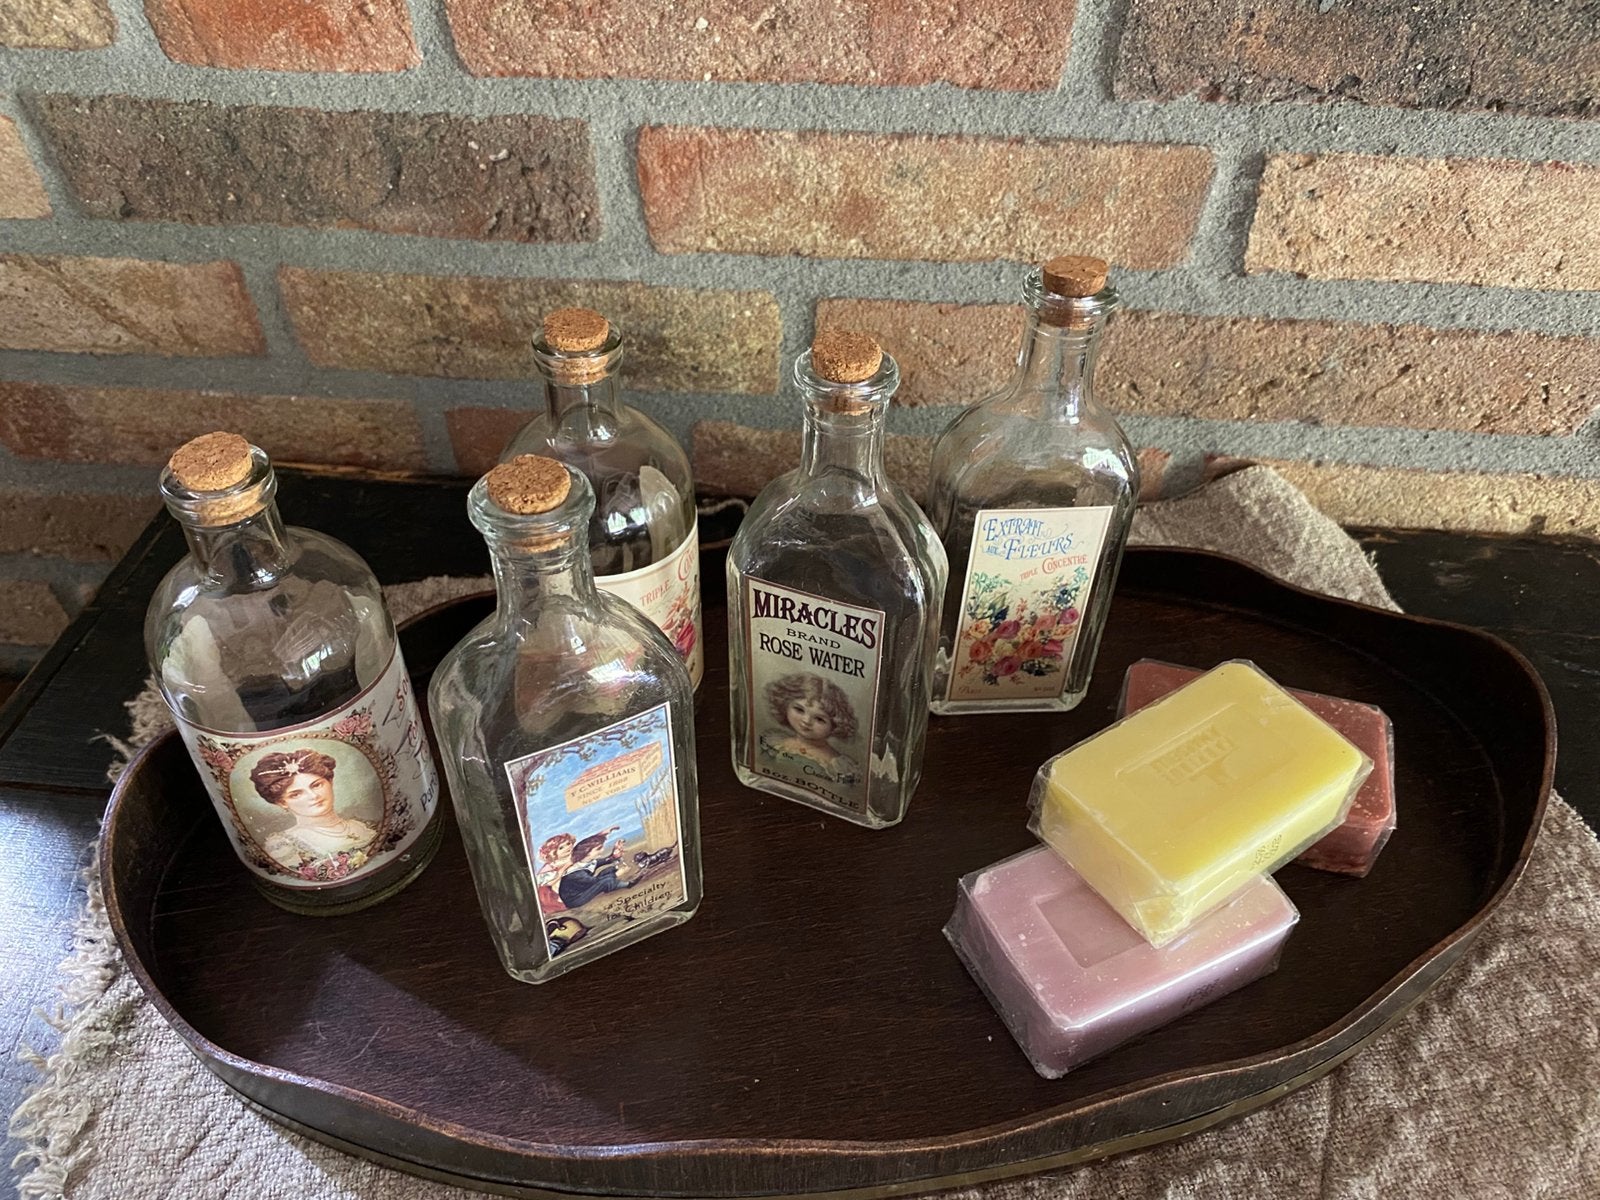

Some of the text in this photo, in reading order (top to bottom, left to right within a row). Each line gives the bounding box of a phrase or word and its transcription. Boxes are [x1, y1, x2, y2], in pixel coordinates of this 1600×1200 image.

[1003, 532, 1074, 560] FLEURS
[752, 588, 877, 649] MIRACLES
[786, 627, 841, 649] BRAND
[759, 632, 865, 679] ROSE WATER
[795, 777, 860, 810] BOTTLE
[616, 881, 666, 906] Specialty
